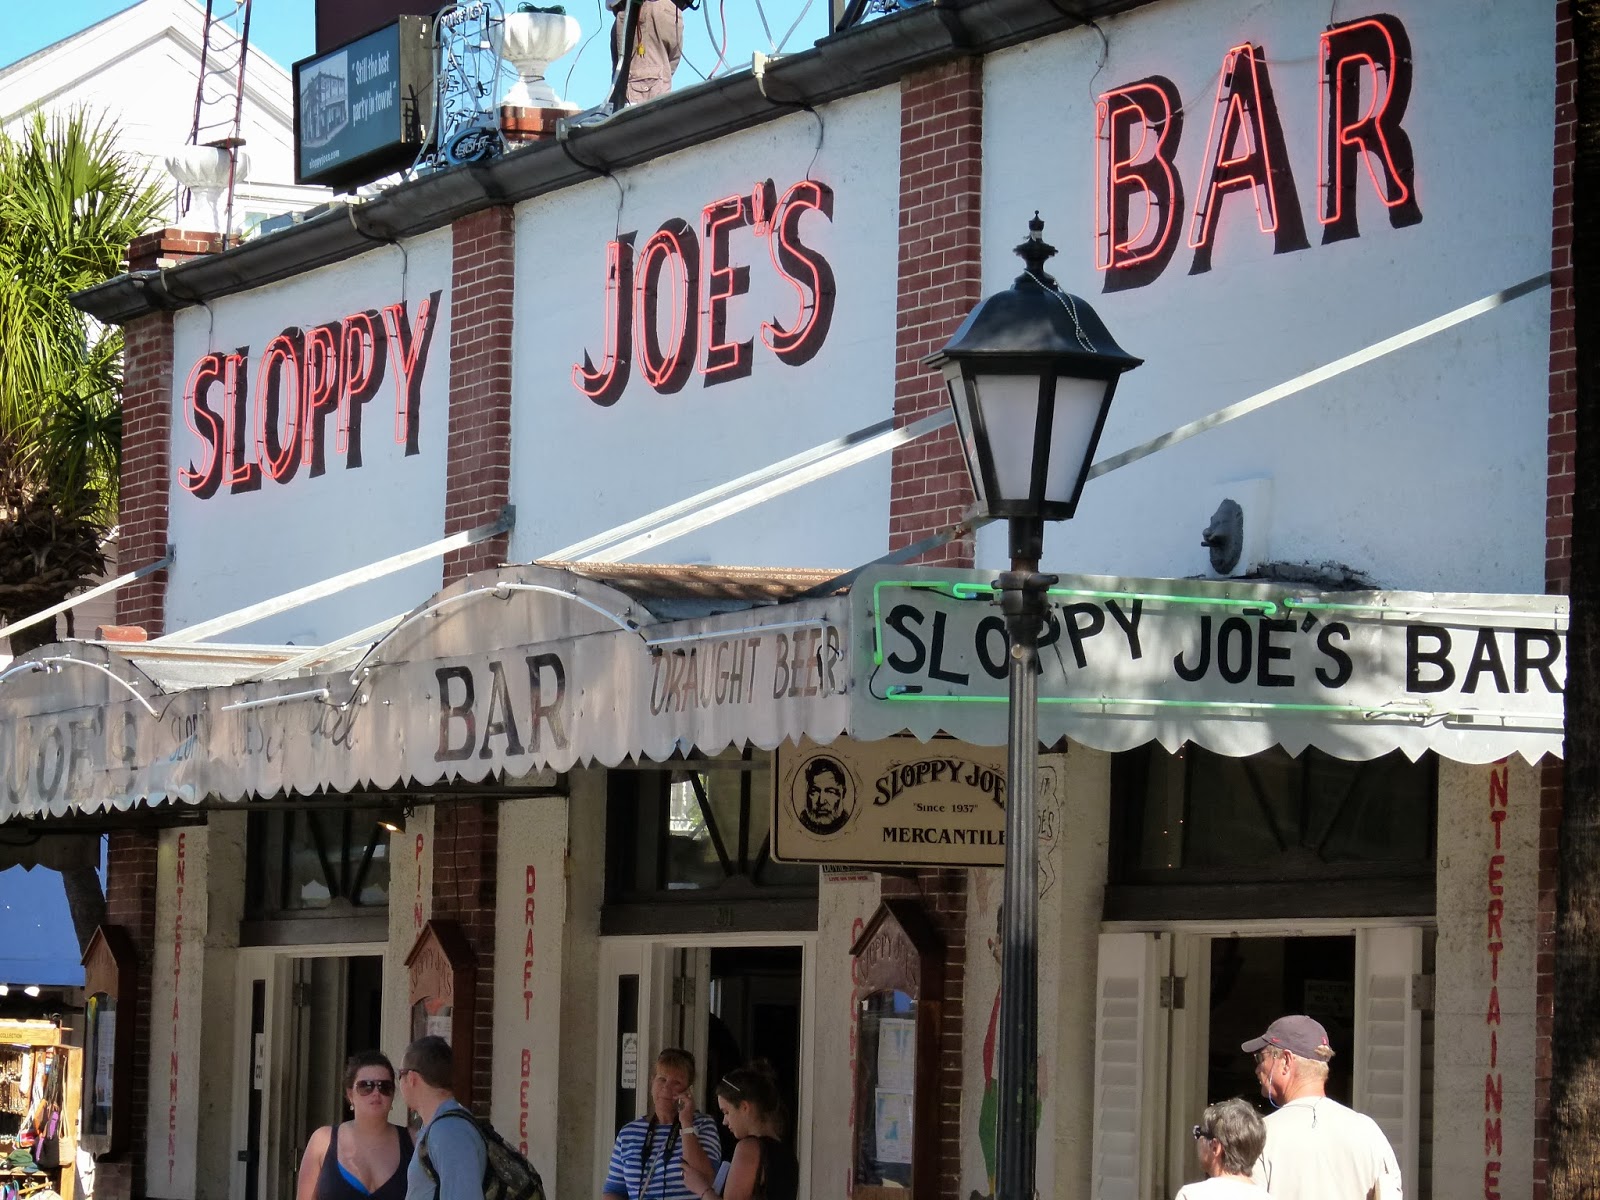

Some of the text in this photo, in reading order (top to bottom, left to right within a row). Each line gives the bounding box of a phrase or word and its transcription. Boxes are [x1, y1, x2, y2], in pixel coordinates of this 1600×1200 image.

[352, 97, 369, 127] party
[368, 92, 375, 115] in
[368, 53, 378, 80] the
[378, 50, 390, 76] best
[1095, 13, 1423, 293] BAR
[572, 177, 836, 407] JOE'S
[178, 289, 442, 500] SLOPPY
[434, 652, 569, 763] BAR
[650, 625, 840, 716] DRAUGHT BEER
[1173, 611, 1353, 688] JOE'S
[1406, 625, 1564, 693] BAR
[873, 760, 965, 806] SLOPPY
[167, 832, 186, 1185] ENTERTAINMENT
[523, 865, 536, 1021] DRAFT
[1484, 757, 1508, 1200] NTERTAINME
